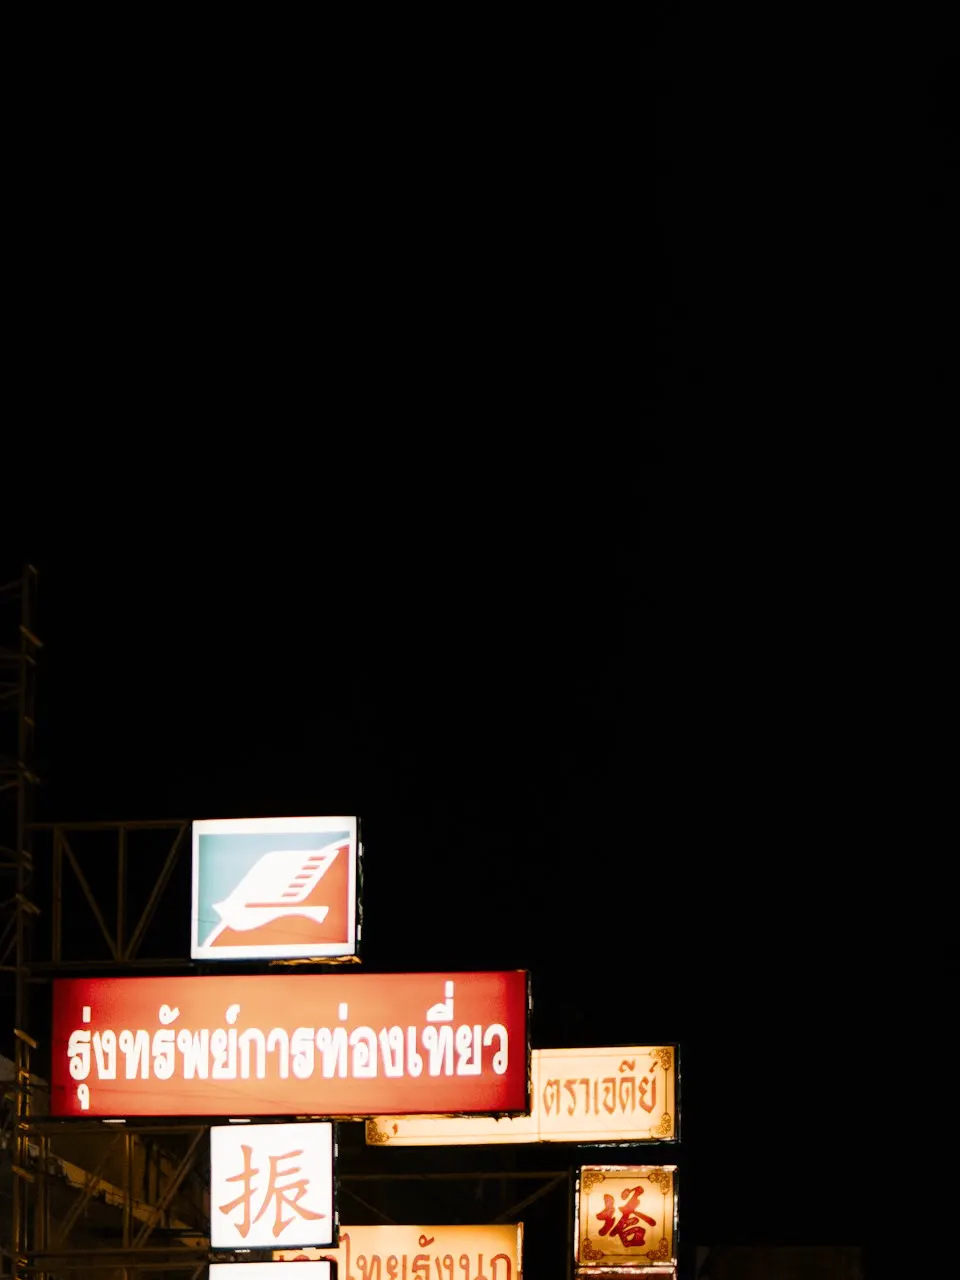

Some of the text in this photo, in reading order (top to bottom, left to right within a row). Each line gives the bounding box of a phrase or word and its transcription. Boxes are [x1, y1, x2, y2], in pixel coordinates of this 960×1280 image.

[67, 981, 510, 1110] รุ่งทรัพย์การท่องเที่ยว
